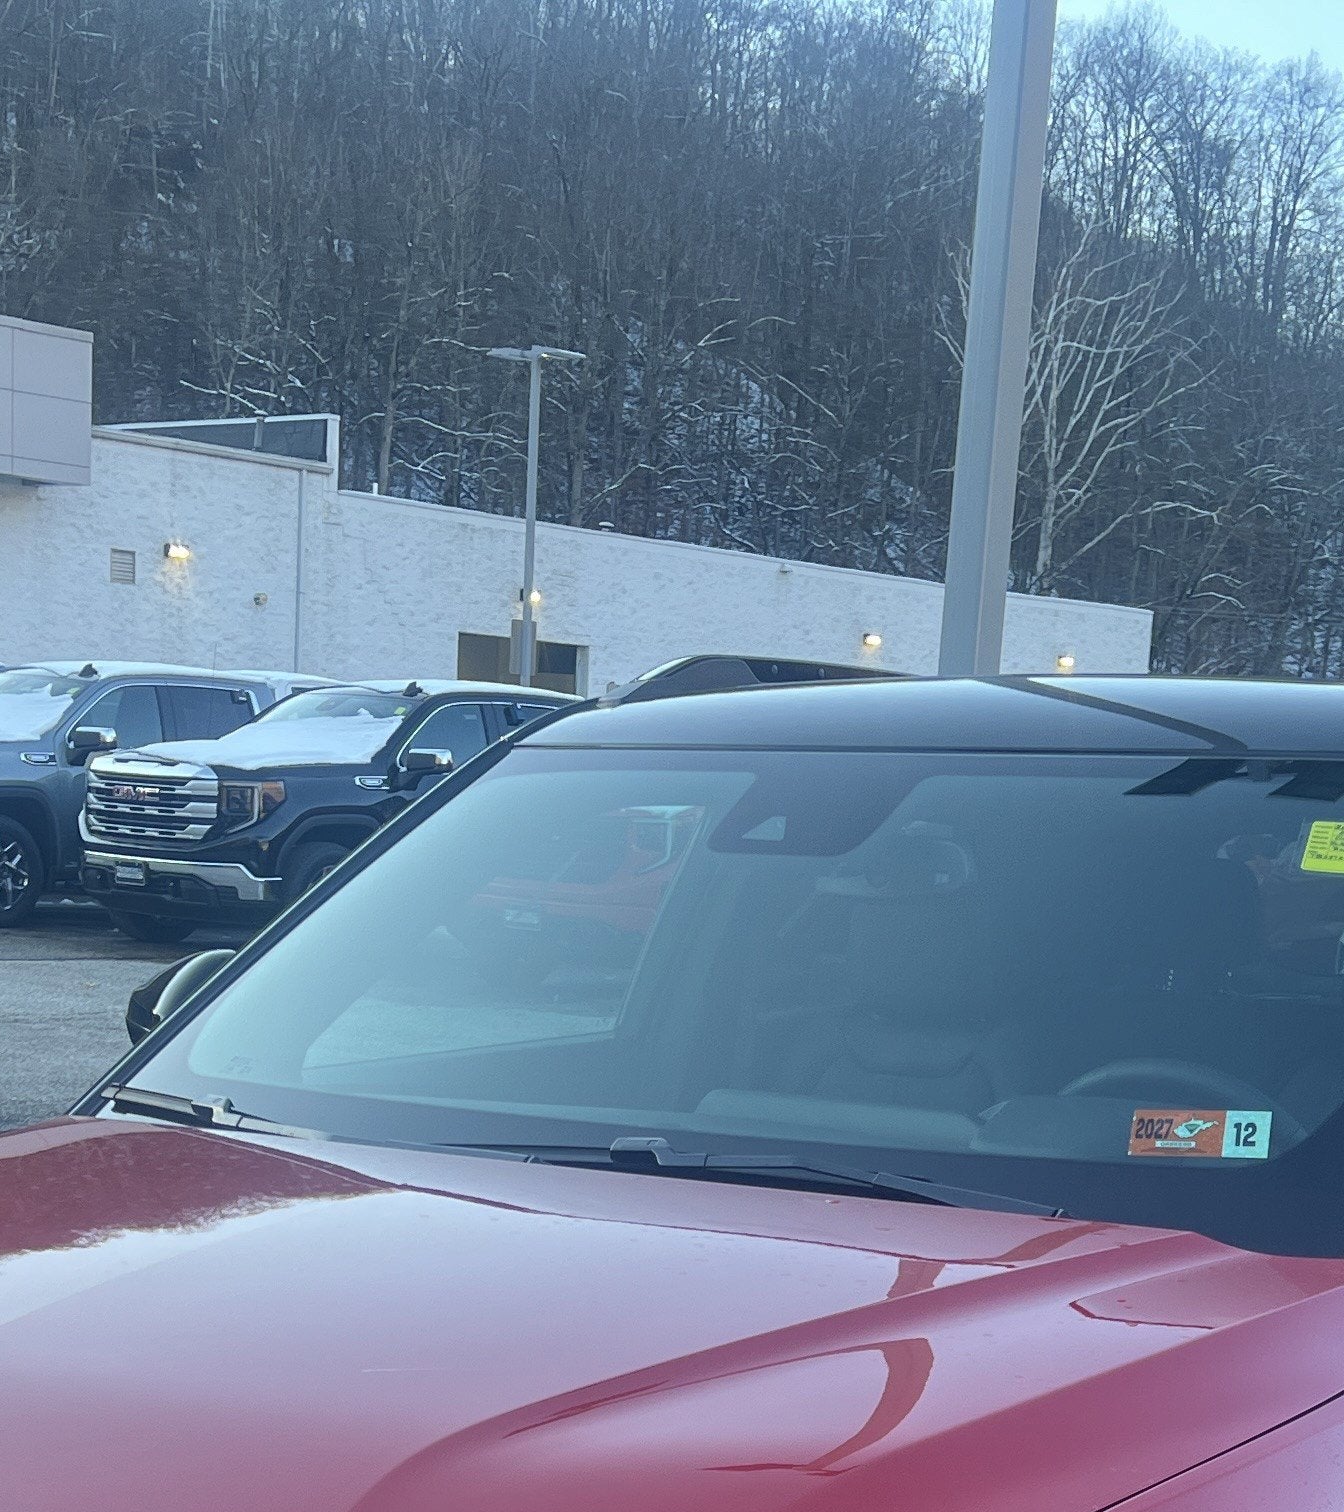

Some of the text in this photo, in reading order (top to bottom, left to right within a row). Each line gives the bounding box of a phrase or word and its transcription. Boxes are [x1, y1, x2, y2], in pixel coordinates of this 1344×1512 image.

[112, 785, 160, 801] GMC
[1135, 1118, 1174, 1139] 2027
[1233, 1122, 1257, 1147] 12
